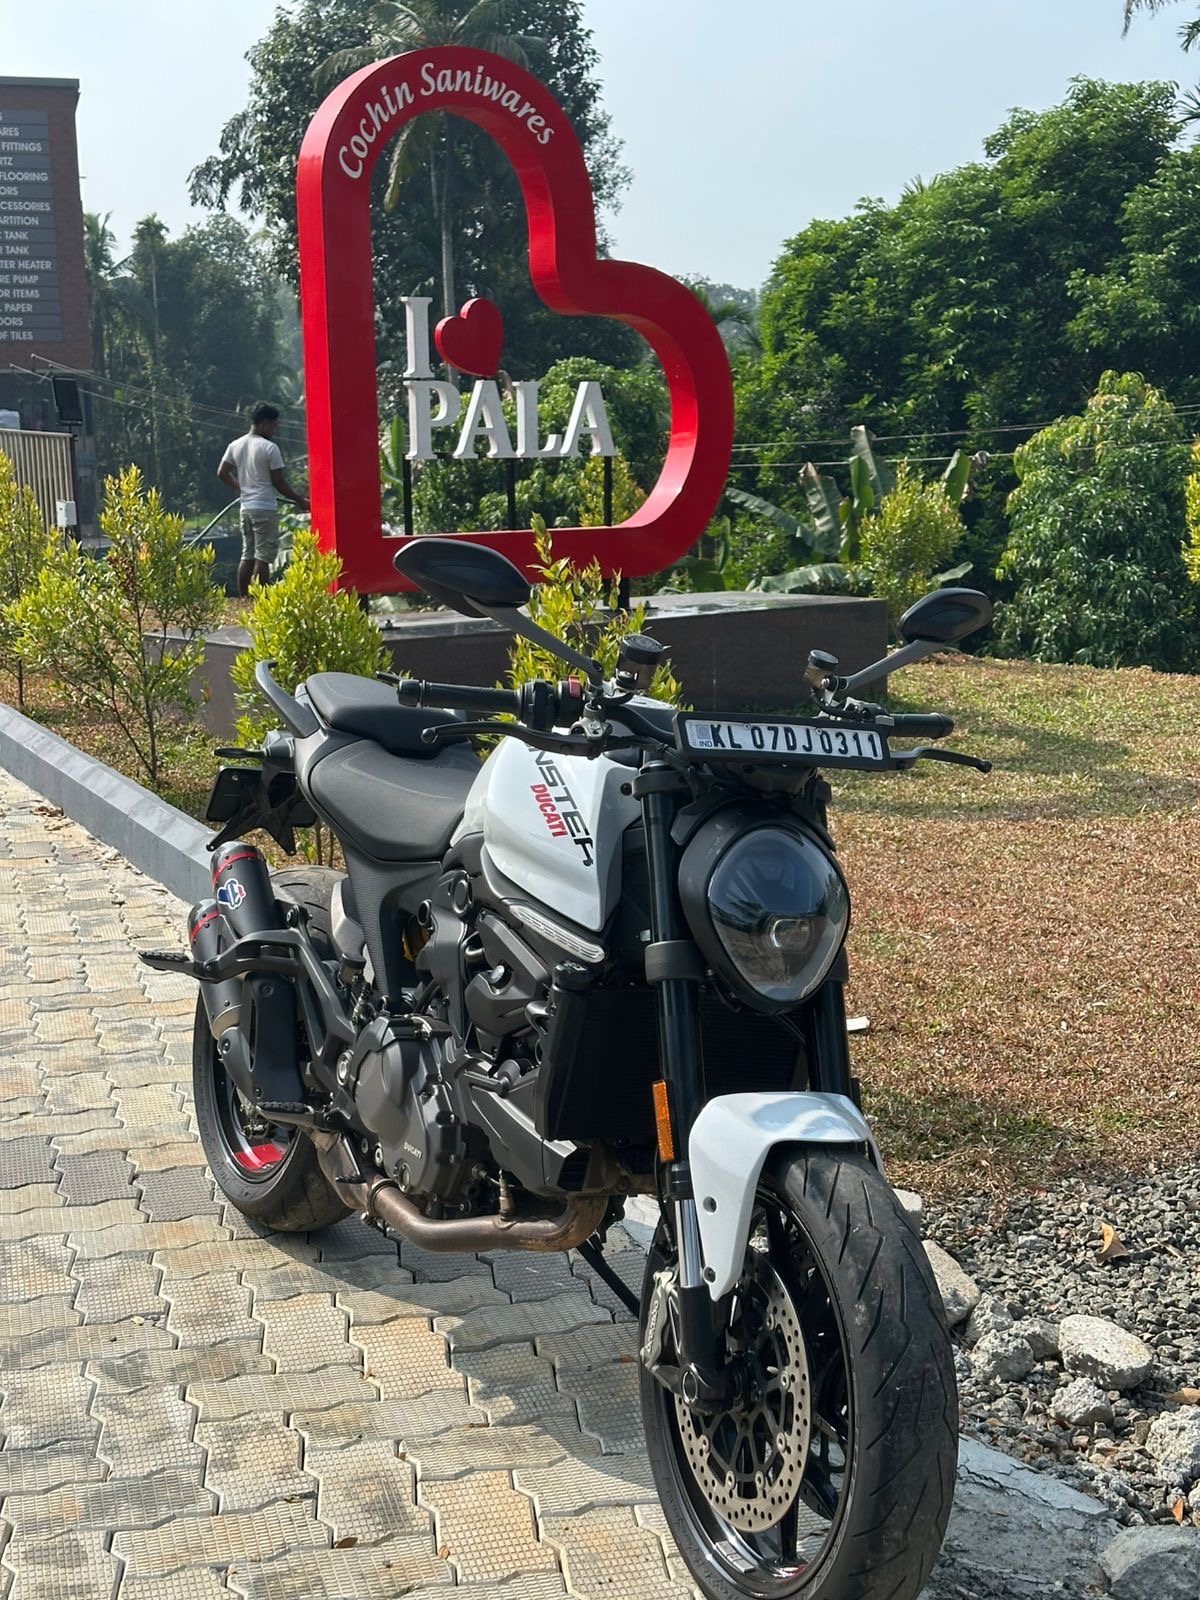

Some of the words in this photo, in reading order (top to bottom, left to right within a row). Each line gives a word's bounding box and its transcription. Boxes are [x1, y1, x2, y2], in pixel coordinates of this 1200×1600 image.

[339, 82, 414, 179] Cochin
[420, 62, 555, 145] Saniwares
[2, 142, 42, 152] FITTINGS
[0, 172, 48, 182] FLOORING
[4, 231, 29, 240] TANK
[5, 246, 30, 255] TANK
[18, 260, 52, 270] HEATER
[13, 275, 39, 284] PUMP
[13, 289, 40, 299] ITEMS
[4, 304, 33, 313] PAPER
[10, 331, 34, 340] TILES
[400, 296, 435, 379] I
[403, 380, 619, 460] PALA
[530, 784, 568, 837] DUCATI
